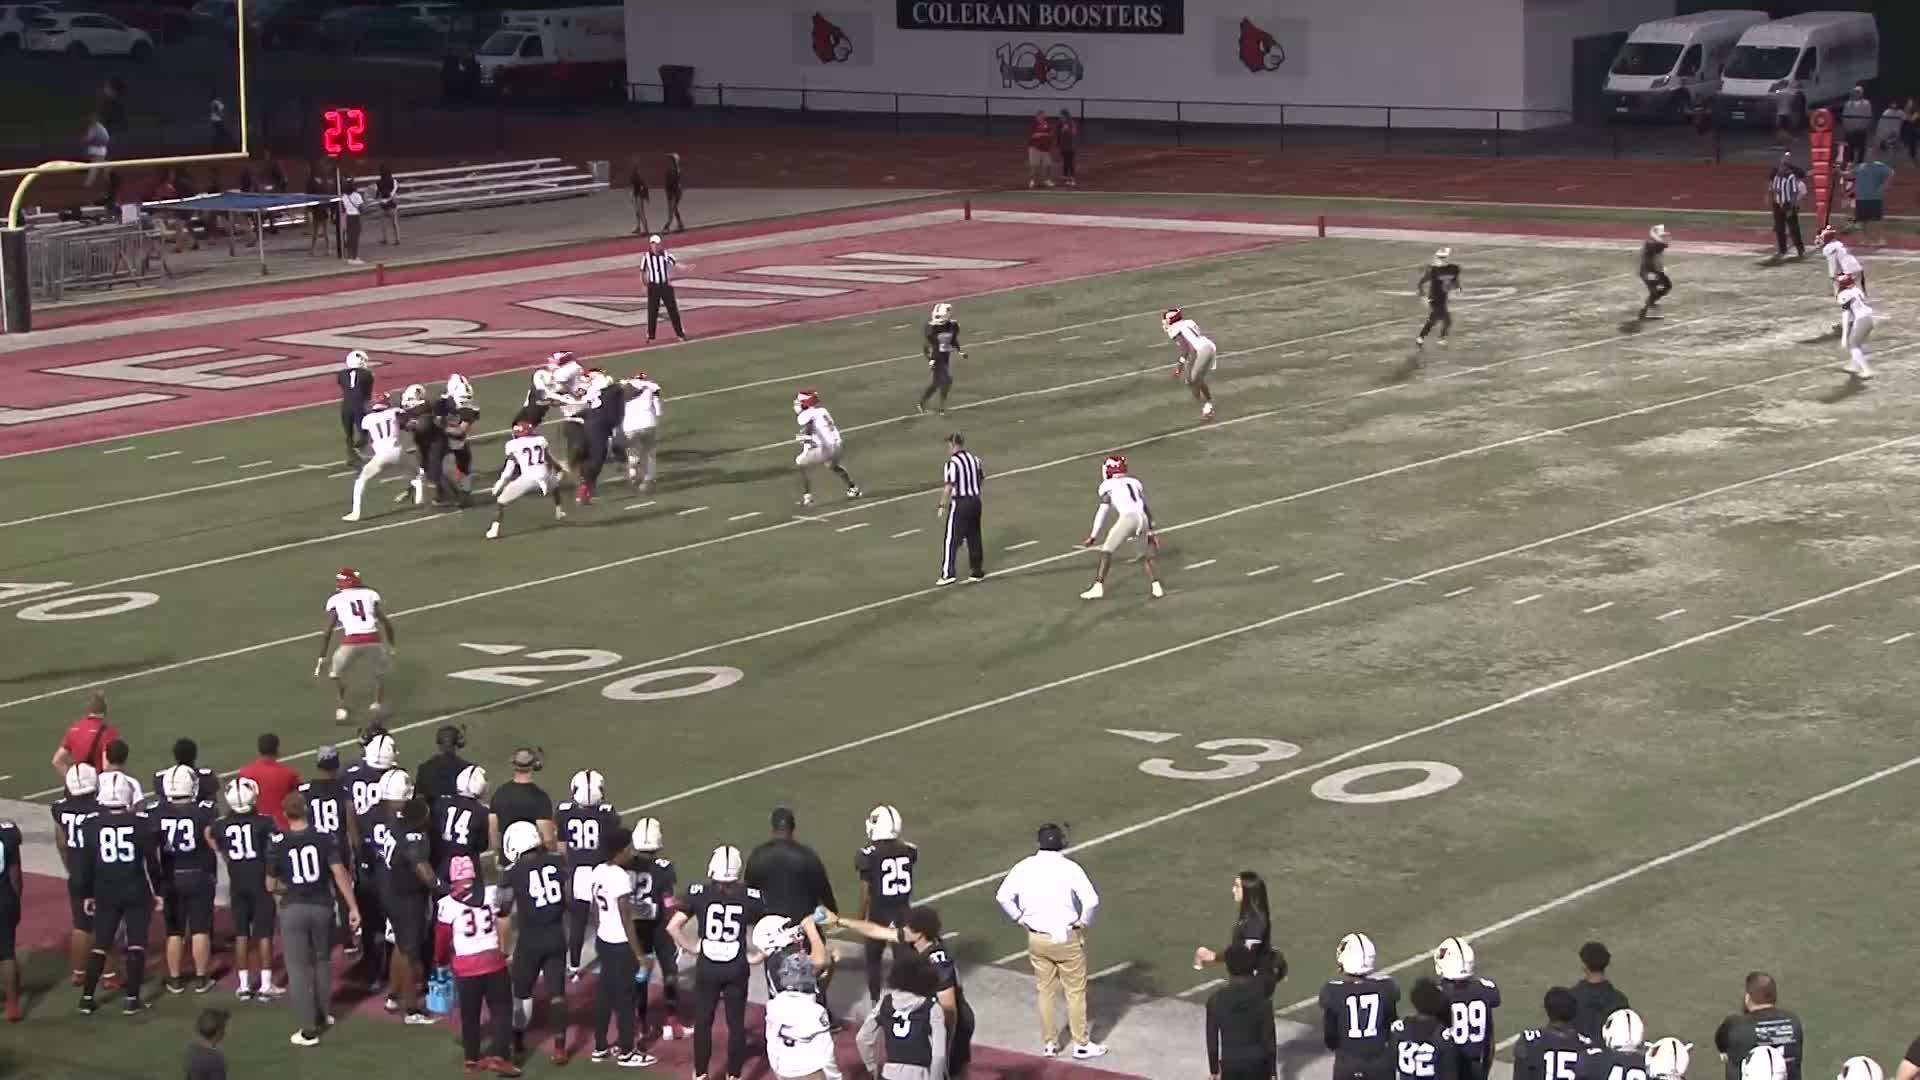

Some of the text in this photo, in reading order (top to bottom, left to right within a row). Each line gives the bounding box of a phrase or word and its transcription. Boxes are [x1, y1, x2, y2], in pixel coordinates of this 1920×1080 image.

[913, 1, 1163, 27] COLERAIN BOOSTERS
[323, 109, 365, 153] 22
[349, 369, 357, 389] 1
[522, 445, 545, 467] 22
[1126, 483, 1137, 502] 1
[349, 599, 366, 622] 4
[310, 798, 340, 833] 18
[442, 806, 472, 845] 14
[567, 818, 600, 850] 38
[99, 826, 135, 863] 85
[160, 817, 197, 852] 73
[225, 823, 257, 861] 31
[288, 844, 320, 884] 10
[881, 856, 912, 896] 25
[528, 865, 562, 908] 46
[461, 905, 494, 938] 33
[705, 903, 744, 942] 65
[1345, 993, 1381, 1039] 17
[1451, 999, 1488, 1045] 89
[1398, 1040, 1436, 1077] 82
[1543, 1050, 1579, 1080] 15
